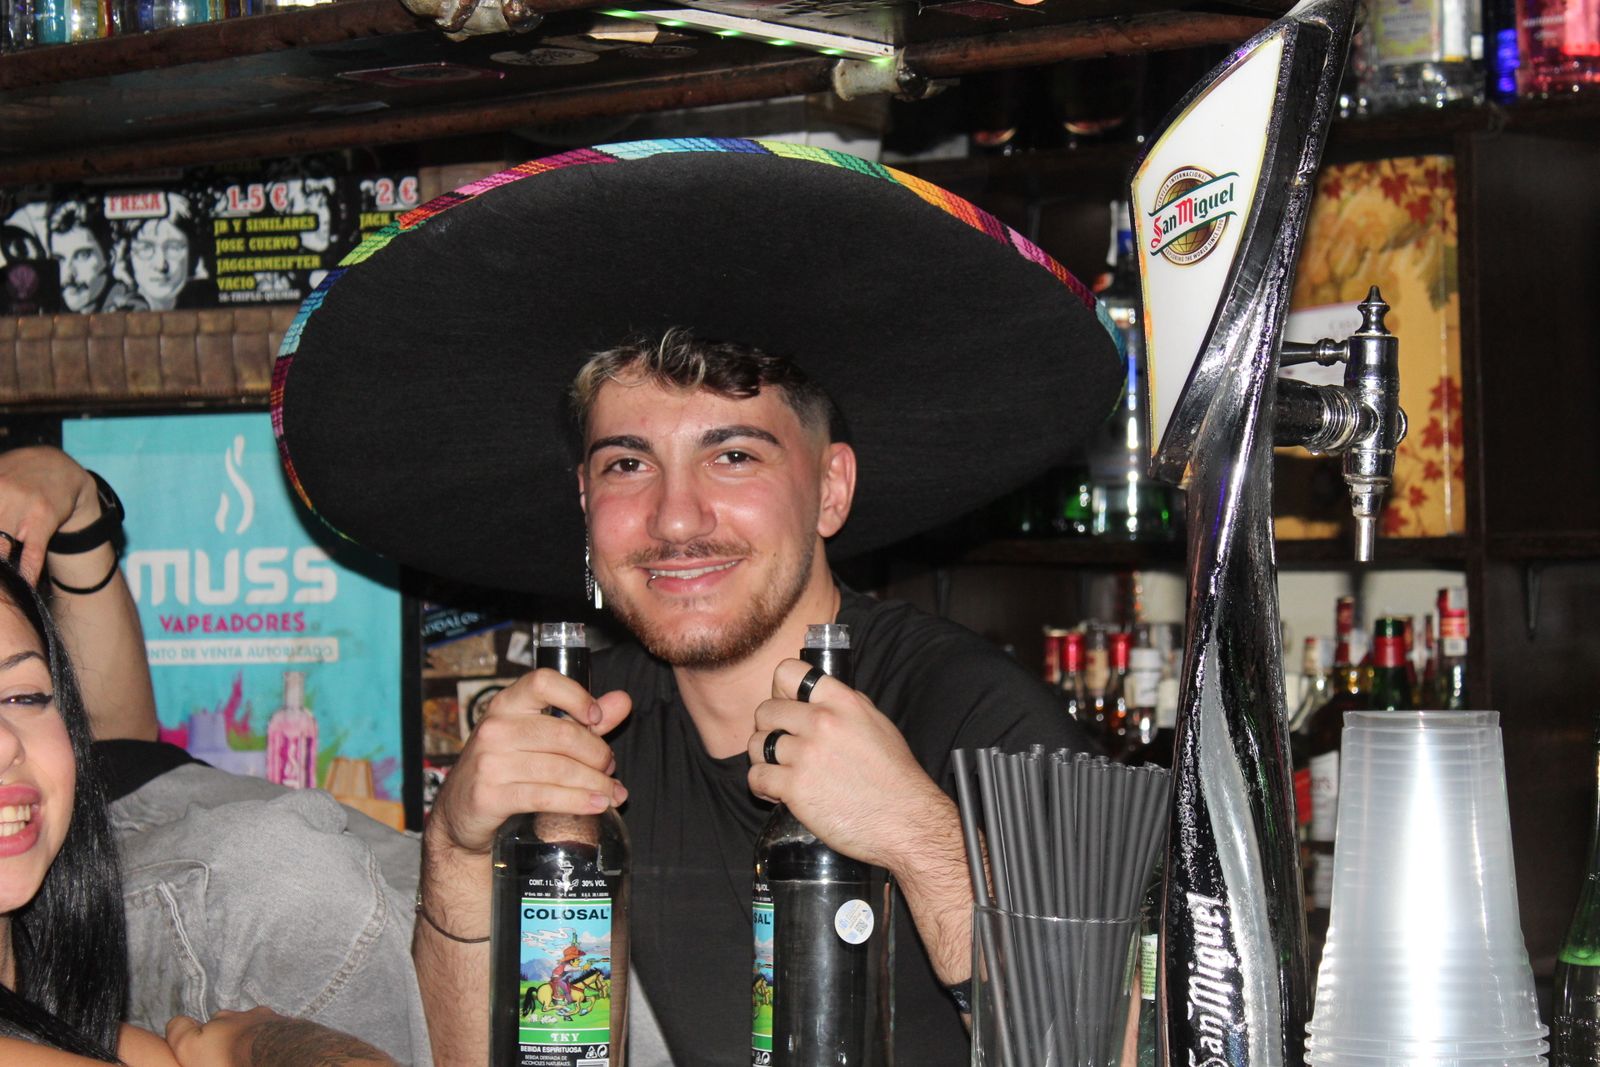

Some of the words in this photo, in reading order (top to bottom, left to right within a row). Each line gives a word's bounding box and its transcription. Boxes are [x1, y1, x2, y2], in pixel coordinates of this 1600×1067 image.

[227, 184, 265, 211] 1.5
[376, 178, 395, 207] 2
[1151, 215, 1177, 248] San
[1175, 182, 1234, 226] Miguel
[232, 219, 242, 233] Y
[246, 216, 316, 232] SIMILARES
[215, 238, 245, 256] JOSE
[248, 236, 299, 251] CUERVO
[1193, 246, 1209, 260] WORLD
[217, 276, 256, 290] VACIO
[126, 547, 337, 606] MUSS
[159, 612, 306, 633] VAPEADORES
[150, 647, 176, 660] NTO
[181, 647, 196, 659] DE
[201, 646, 242, 659] VENTA
[249, 644, 333, 658] AUTORIZADO
[582, 879, 594, 887] 30%
[523, 908, 609, 920] COLOSAL
[1186, 892, 1236, 1020] Miguel
[550, 1033, 580, 1042] TKY
[521, 1045, 541, 1053] BEBIDA
